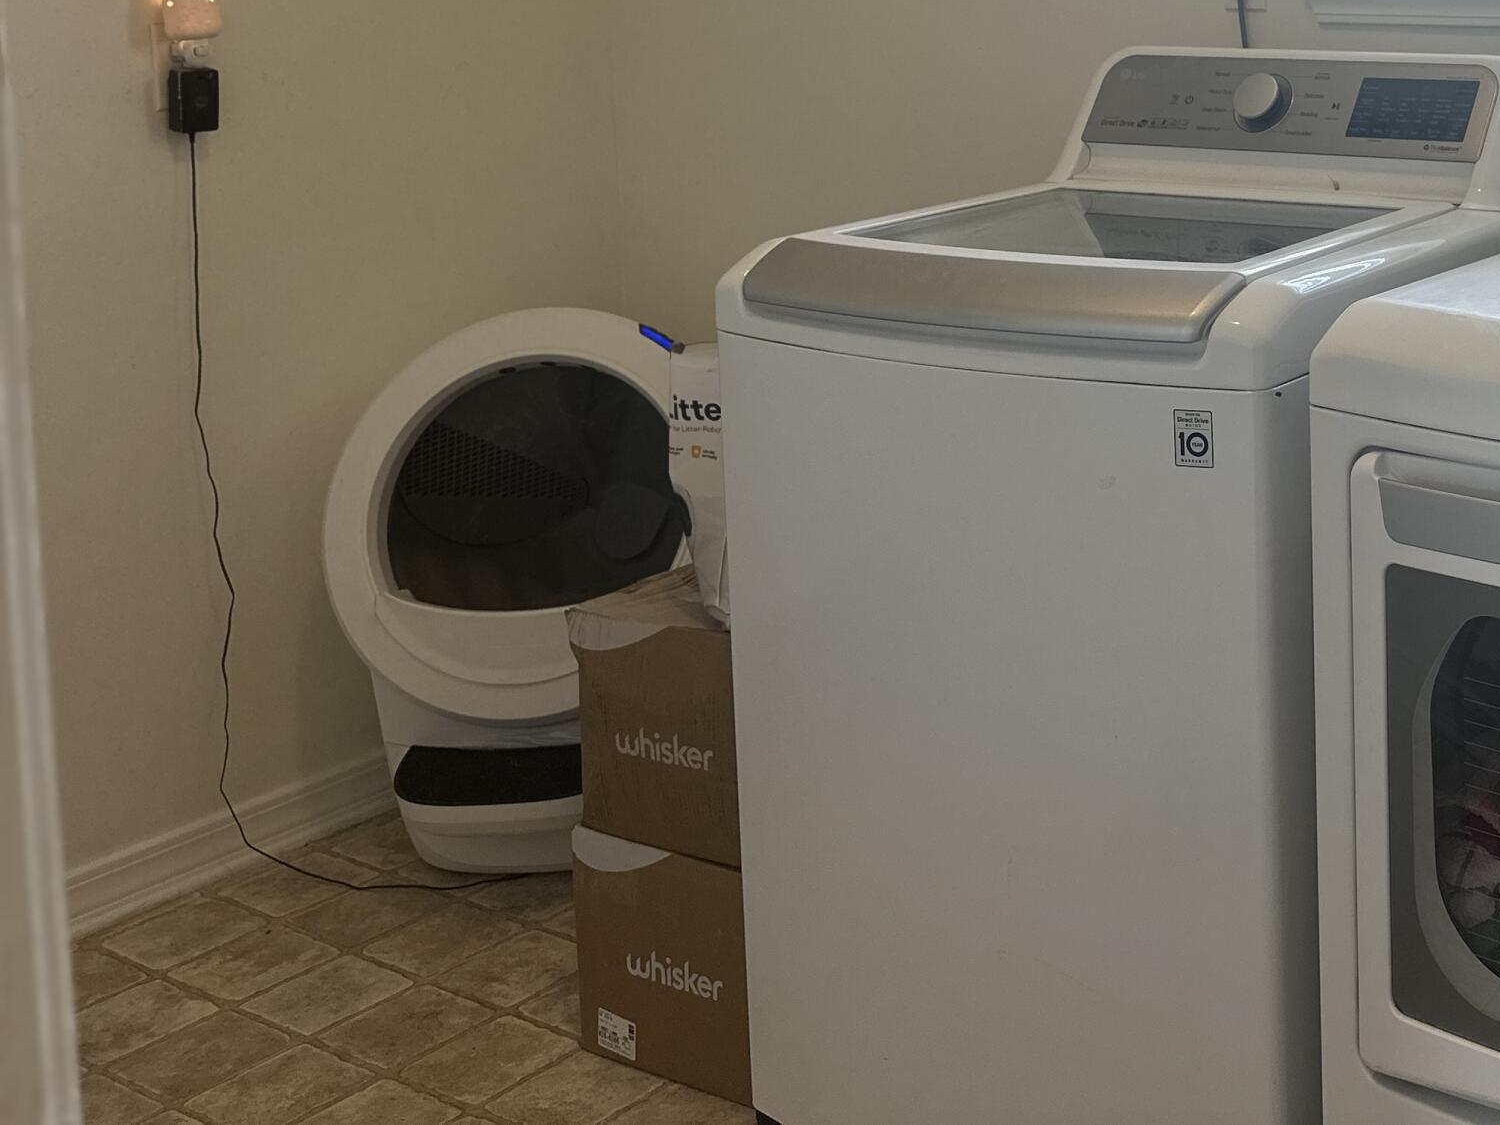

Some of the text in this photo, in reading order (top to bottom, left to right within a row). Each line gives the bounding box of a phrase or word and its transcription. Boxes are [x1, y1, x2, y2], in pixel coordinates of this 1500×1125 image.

[669, 394, 721, 421] itte
[1178, 431, 1209, 458] 10
[615, 727, 713, 771] whisker
[626, 950, 723, 1001] whisker
